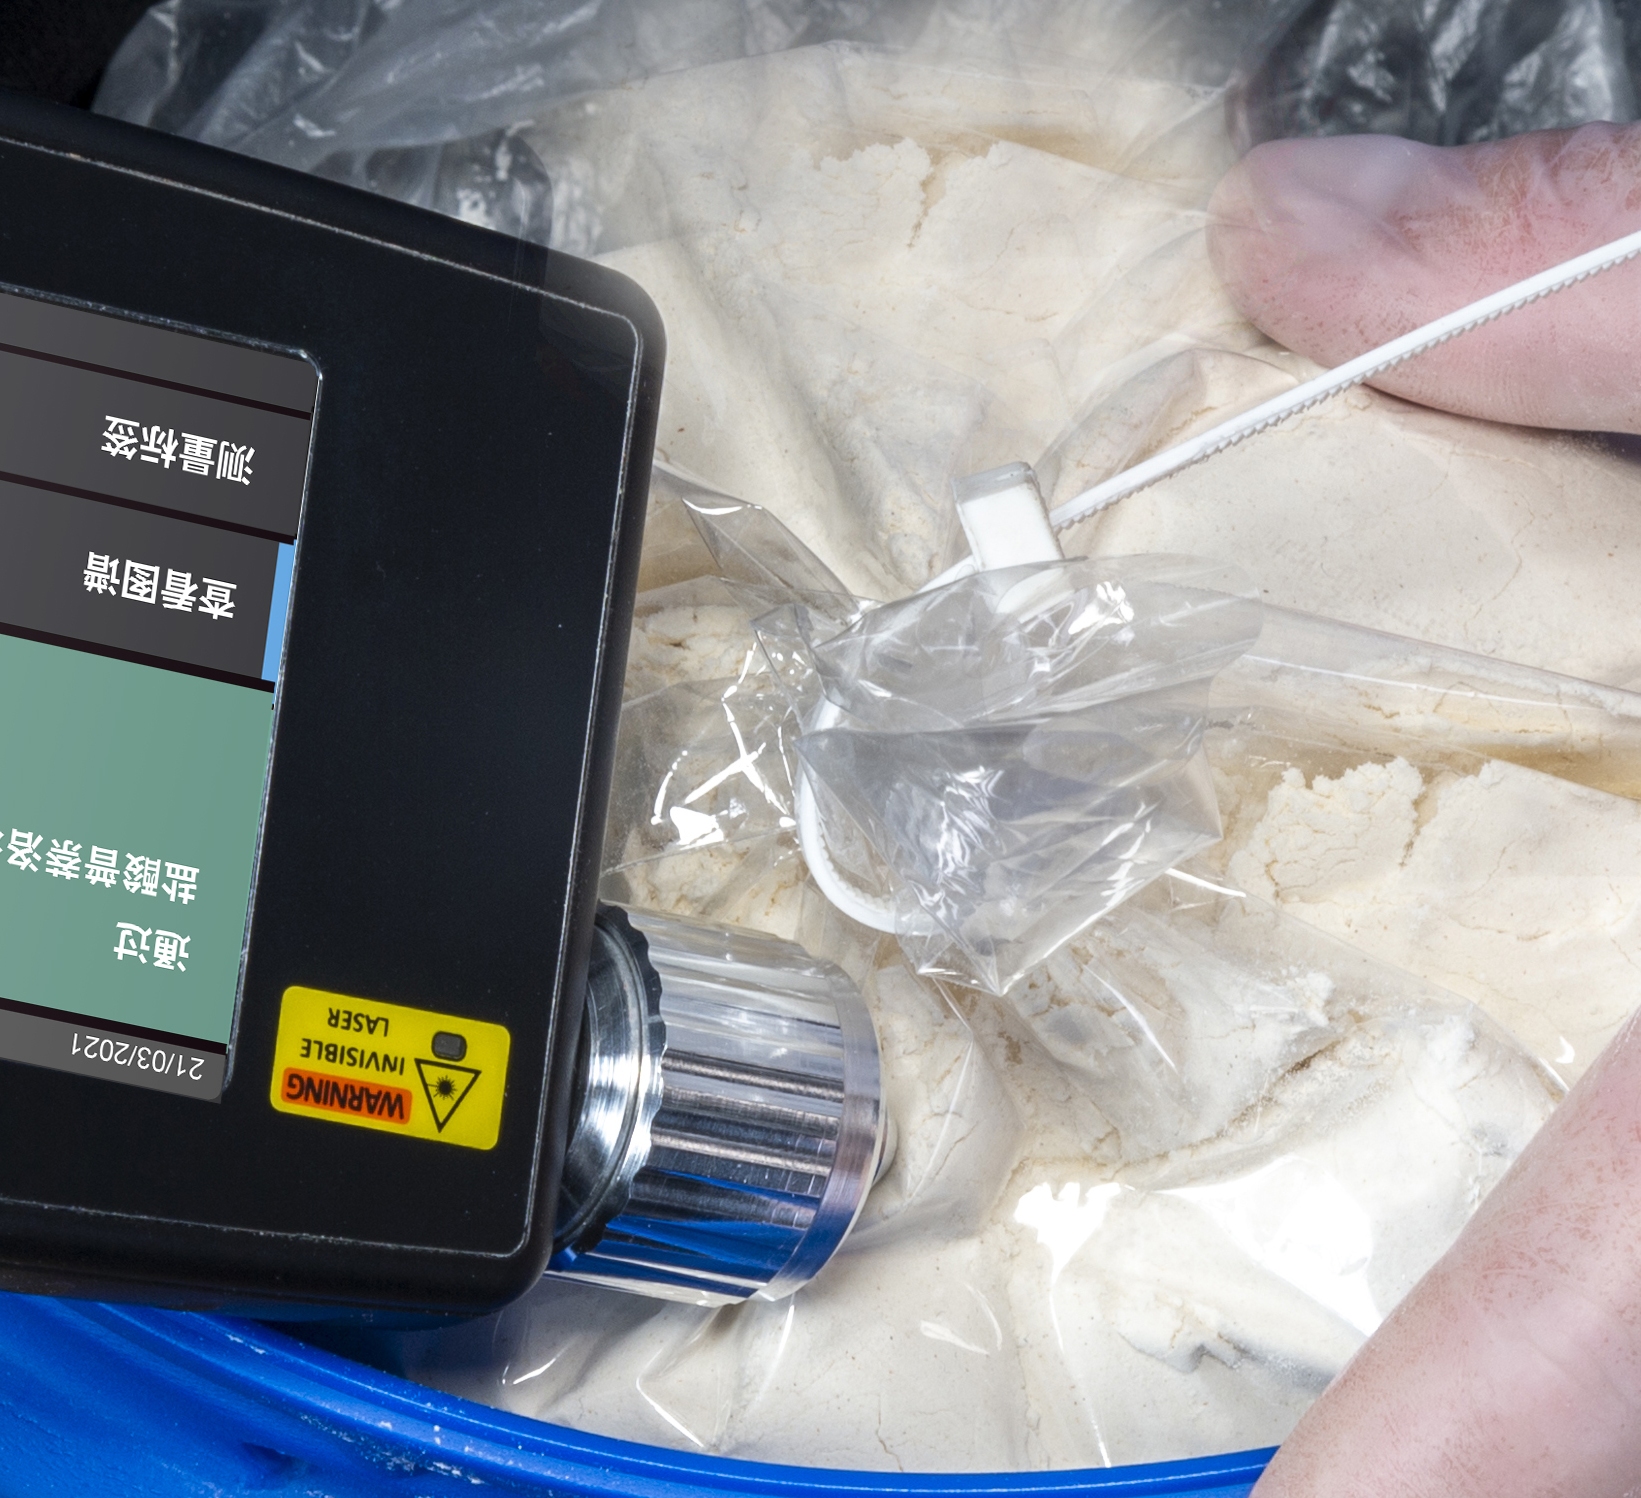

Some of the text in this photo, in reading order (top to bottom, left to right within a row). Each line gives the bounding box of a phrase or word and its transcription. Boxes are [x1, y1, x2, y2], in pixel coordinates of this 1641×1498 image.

[100, 414, 256, 486] 测量标签
[82, 550, 238, 621] 查看图谱
[112, 920, 193, 974] 通过
[327, 1007, 389, 1037] LASER
[69, 1031, 205, 1082] 21/03/2021
[299, 1038, 405, 1075] INVISIBLE
[286, 1073, 405, 1120] WARNING
